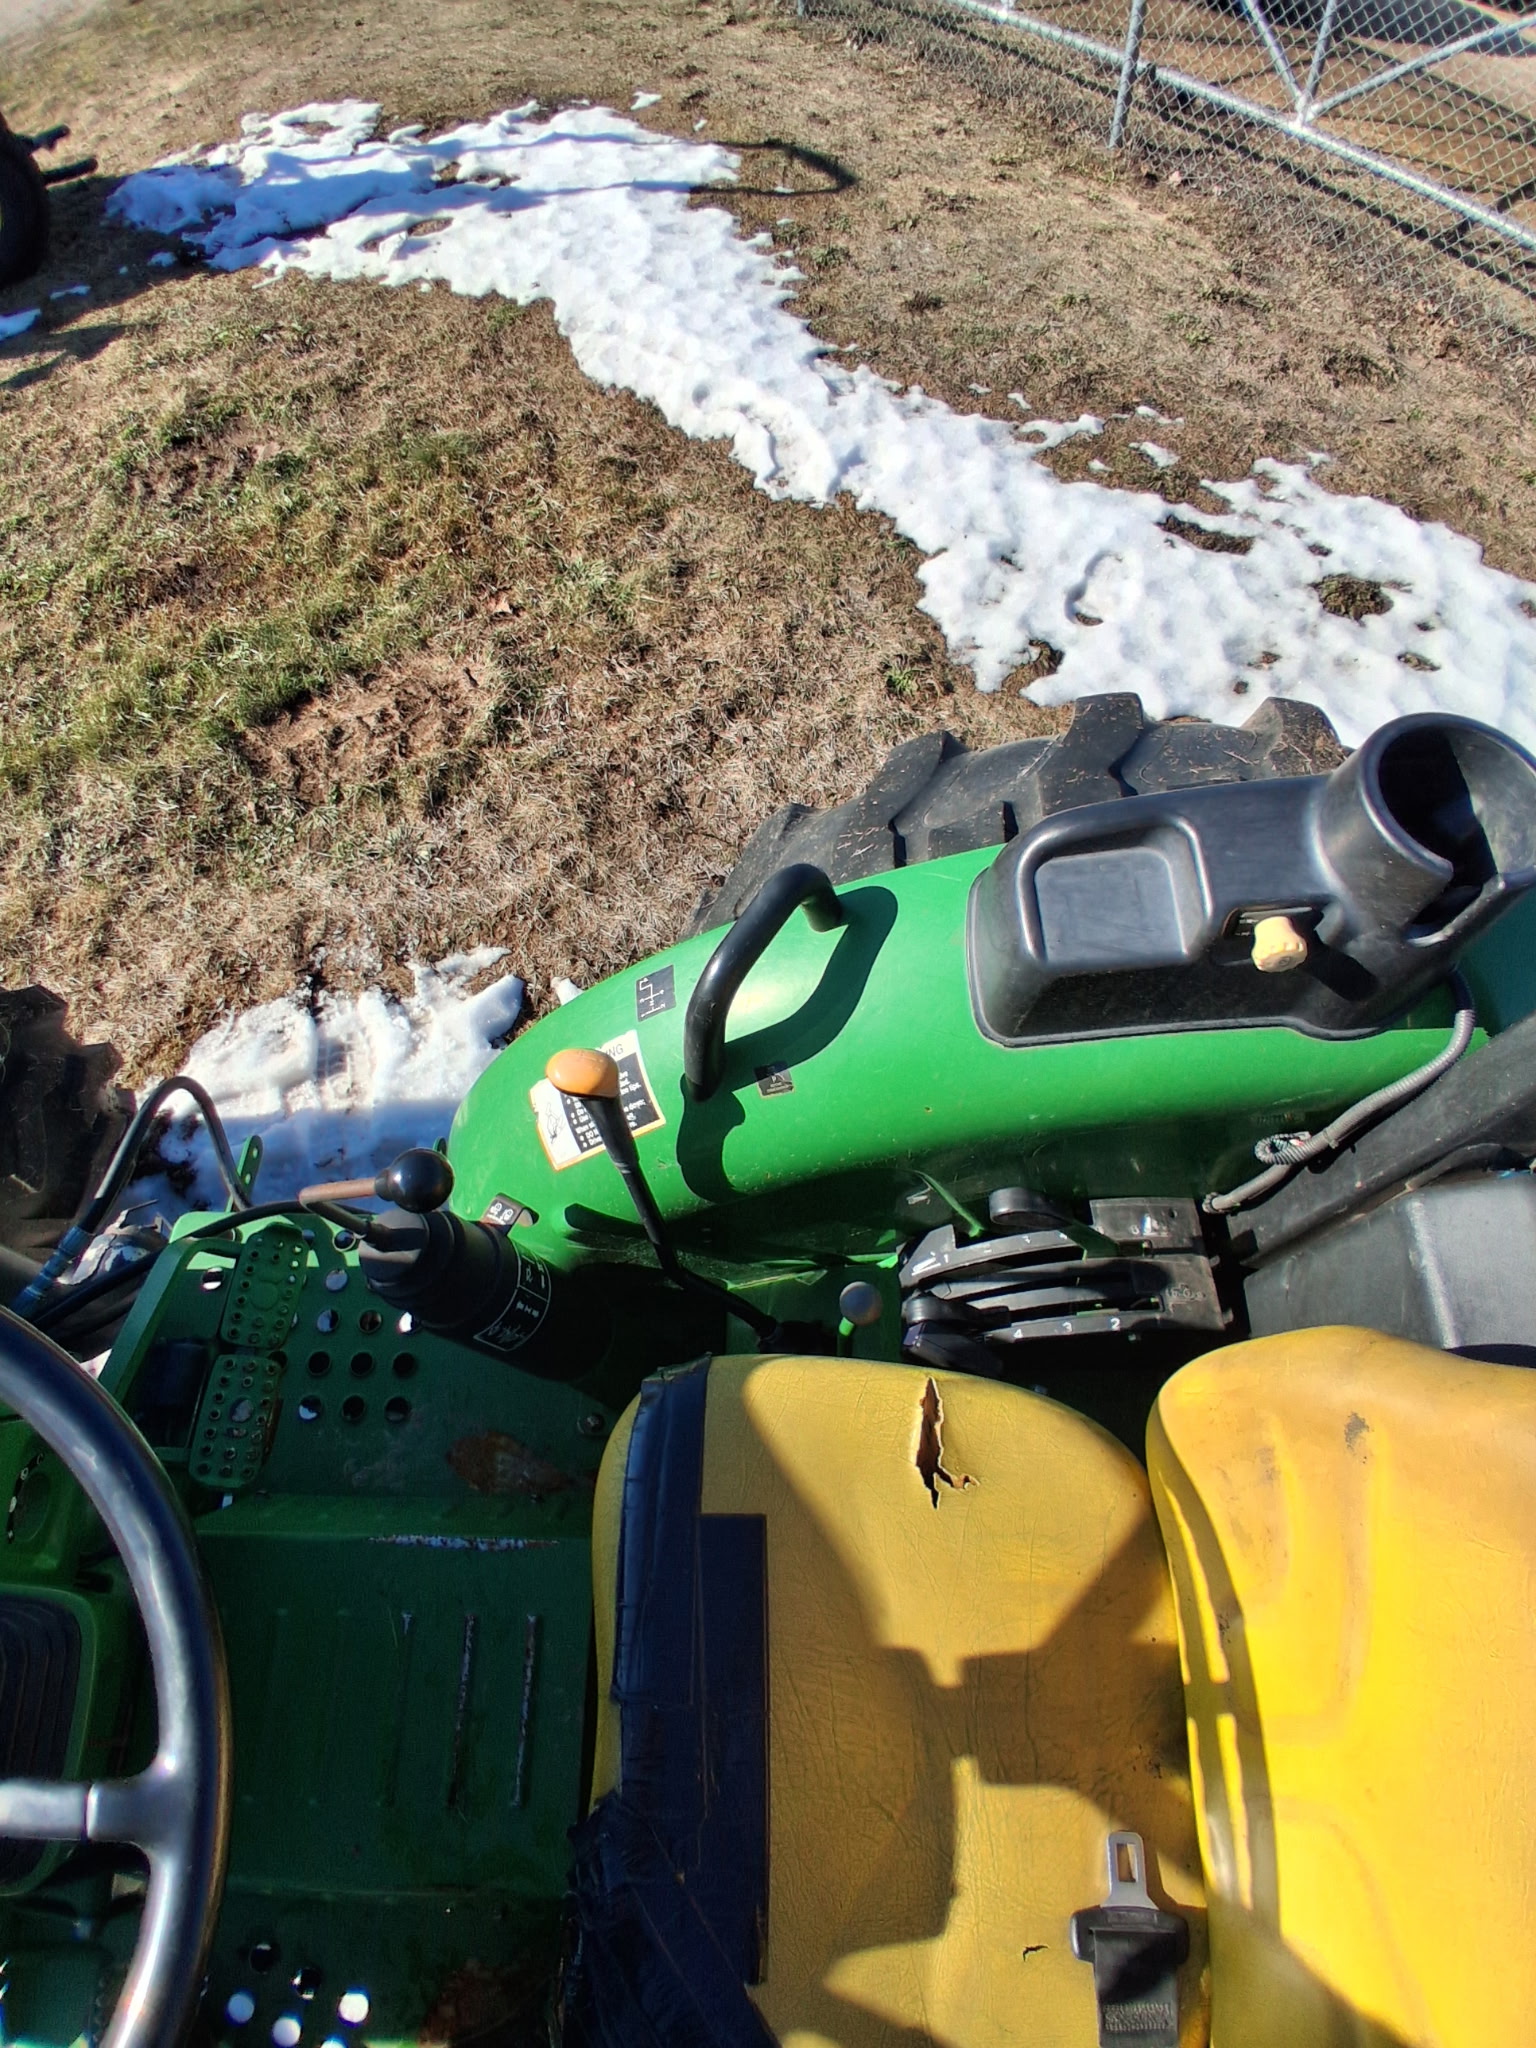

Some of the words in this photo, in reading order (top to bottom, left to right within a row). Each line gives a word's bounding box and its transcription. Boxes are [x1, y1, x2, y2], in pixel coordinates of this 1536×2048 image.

[1013, 1328, 1023, 1338] 4
[1062, 1321, 1073, 1332] 3
[1110, 1317, 1121, 1331] 2
